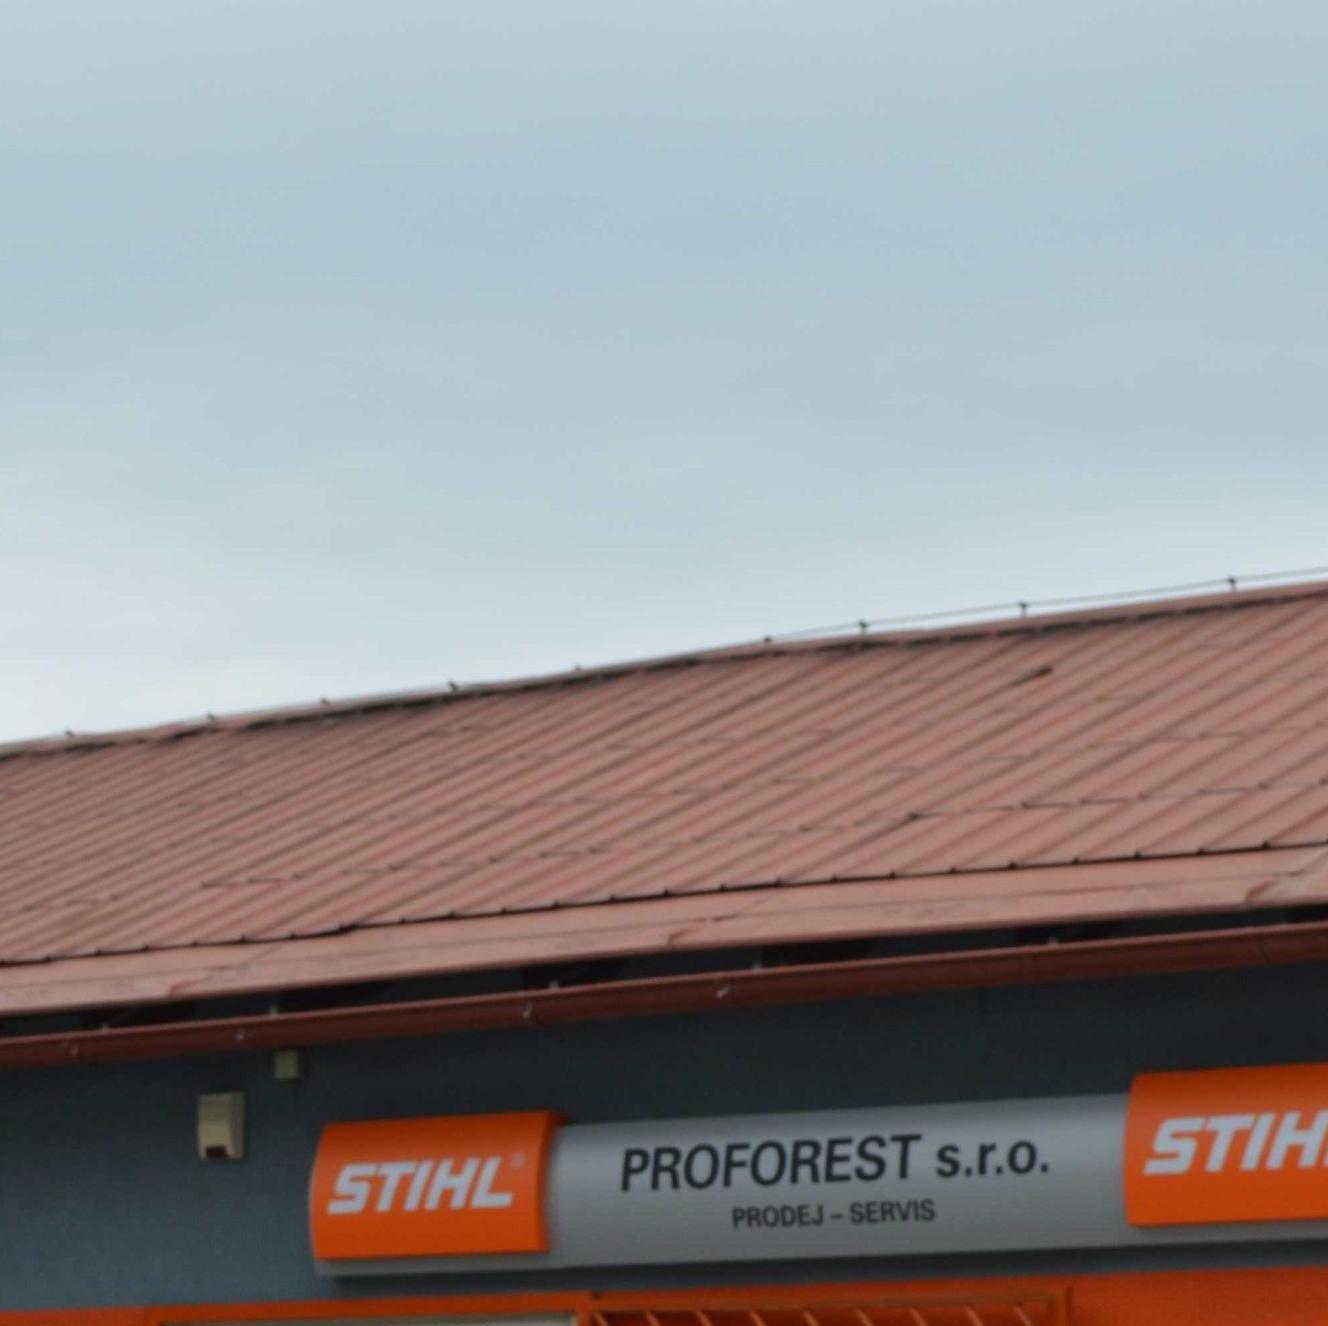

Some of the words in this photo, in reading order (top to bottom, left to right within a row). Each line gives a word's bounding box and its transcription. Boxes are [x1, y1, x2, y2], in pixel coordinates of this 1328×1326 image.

[327, 1156, 514, 1214] STIHL
[621, 1134, 922, 1192] PROFOREST
[936, 1141, 1049, 1179] s.r.o.
[732, 1205, 824, 1228] PRODEJ
[850, 1199, 936, 1224] SERVIS
